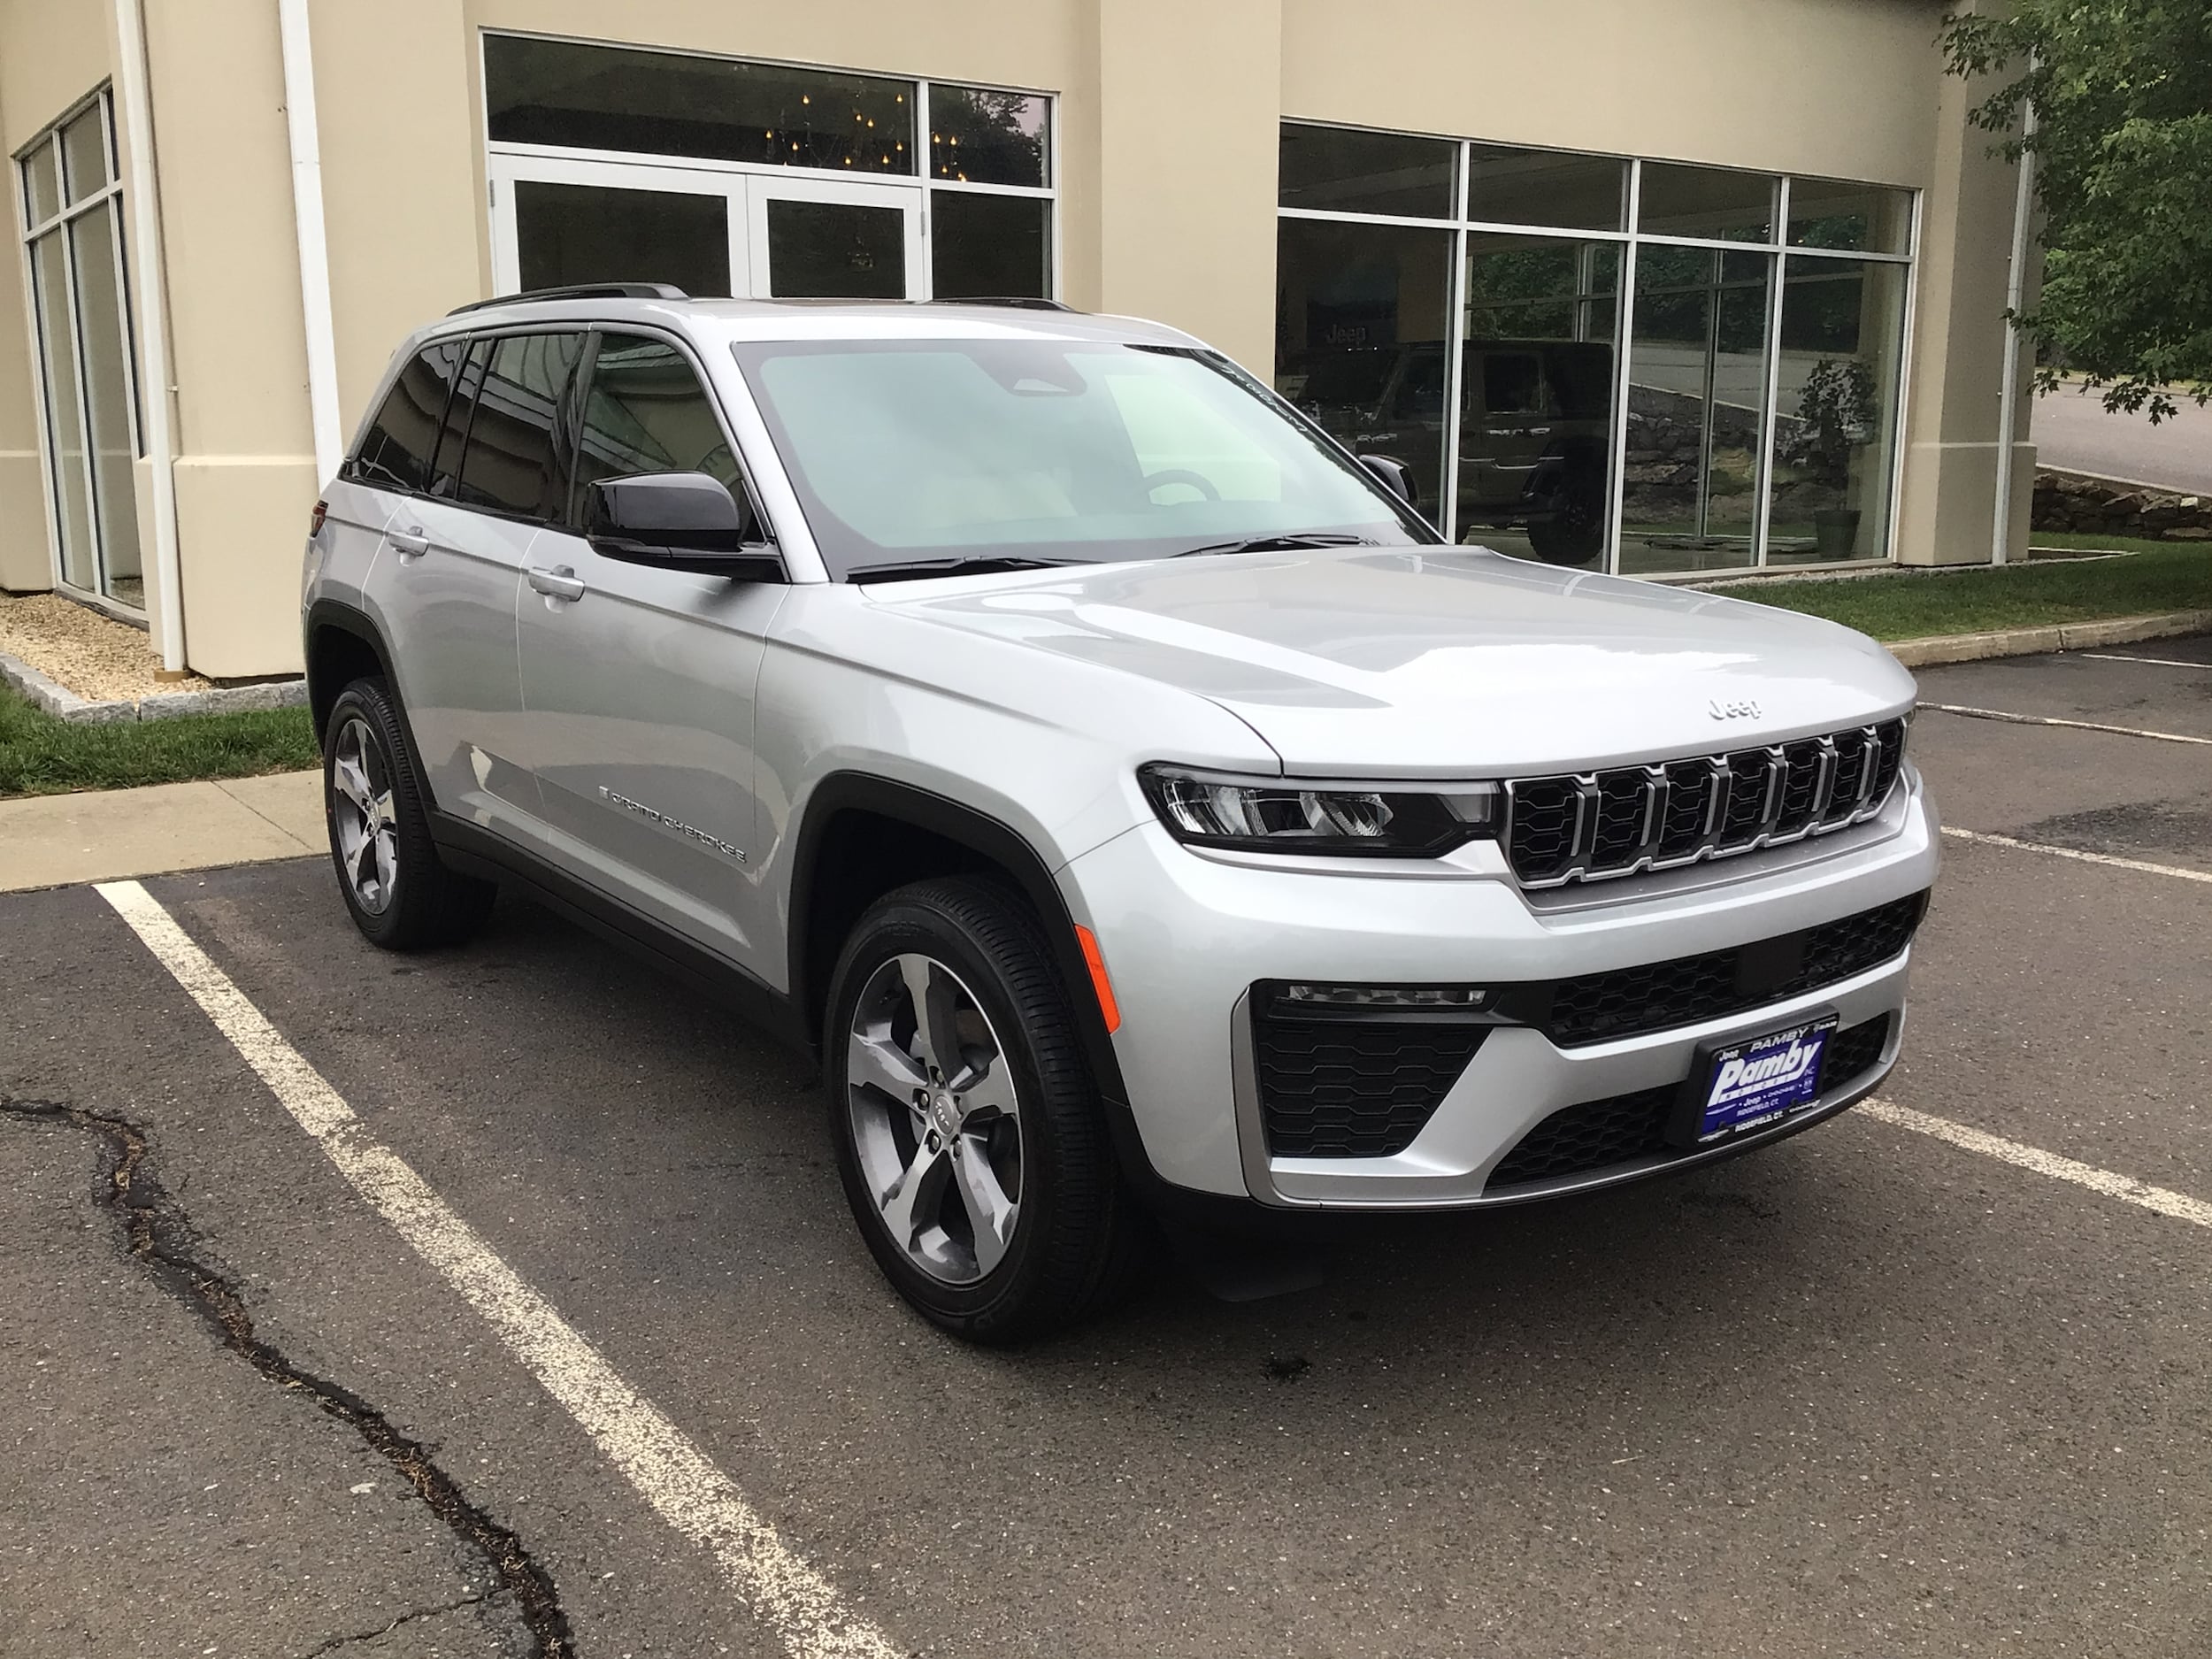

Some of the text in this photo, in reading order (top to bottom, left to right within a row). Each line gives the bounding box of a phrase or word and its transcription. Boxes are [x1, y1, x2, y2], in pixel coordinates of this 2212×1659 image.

[1327, 324, 1366, 345] Jeep
[1709, 698, 1762, 721] Jeep
[611, 792, 748, 864] GRAND CHEROKEE
[1750, 1025, 1809, 1053] PAMBY
[1707, 1040, 1823, 1108] Pamby
